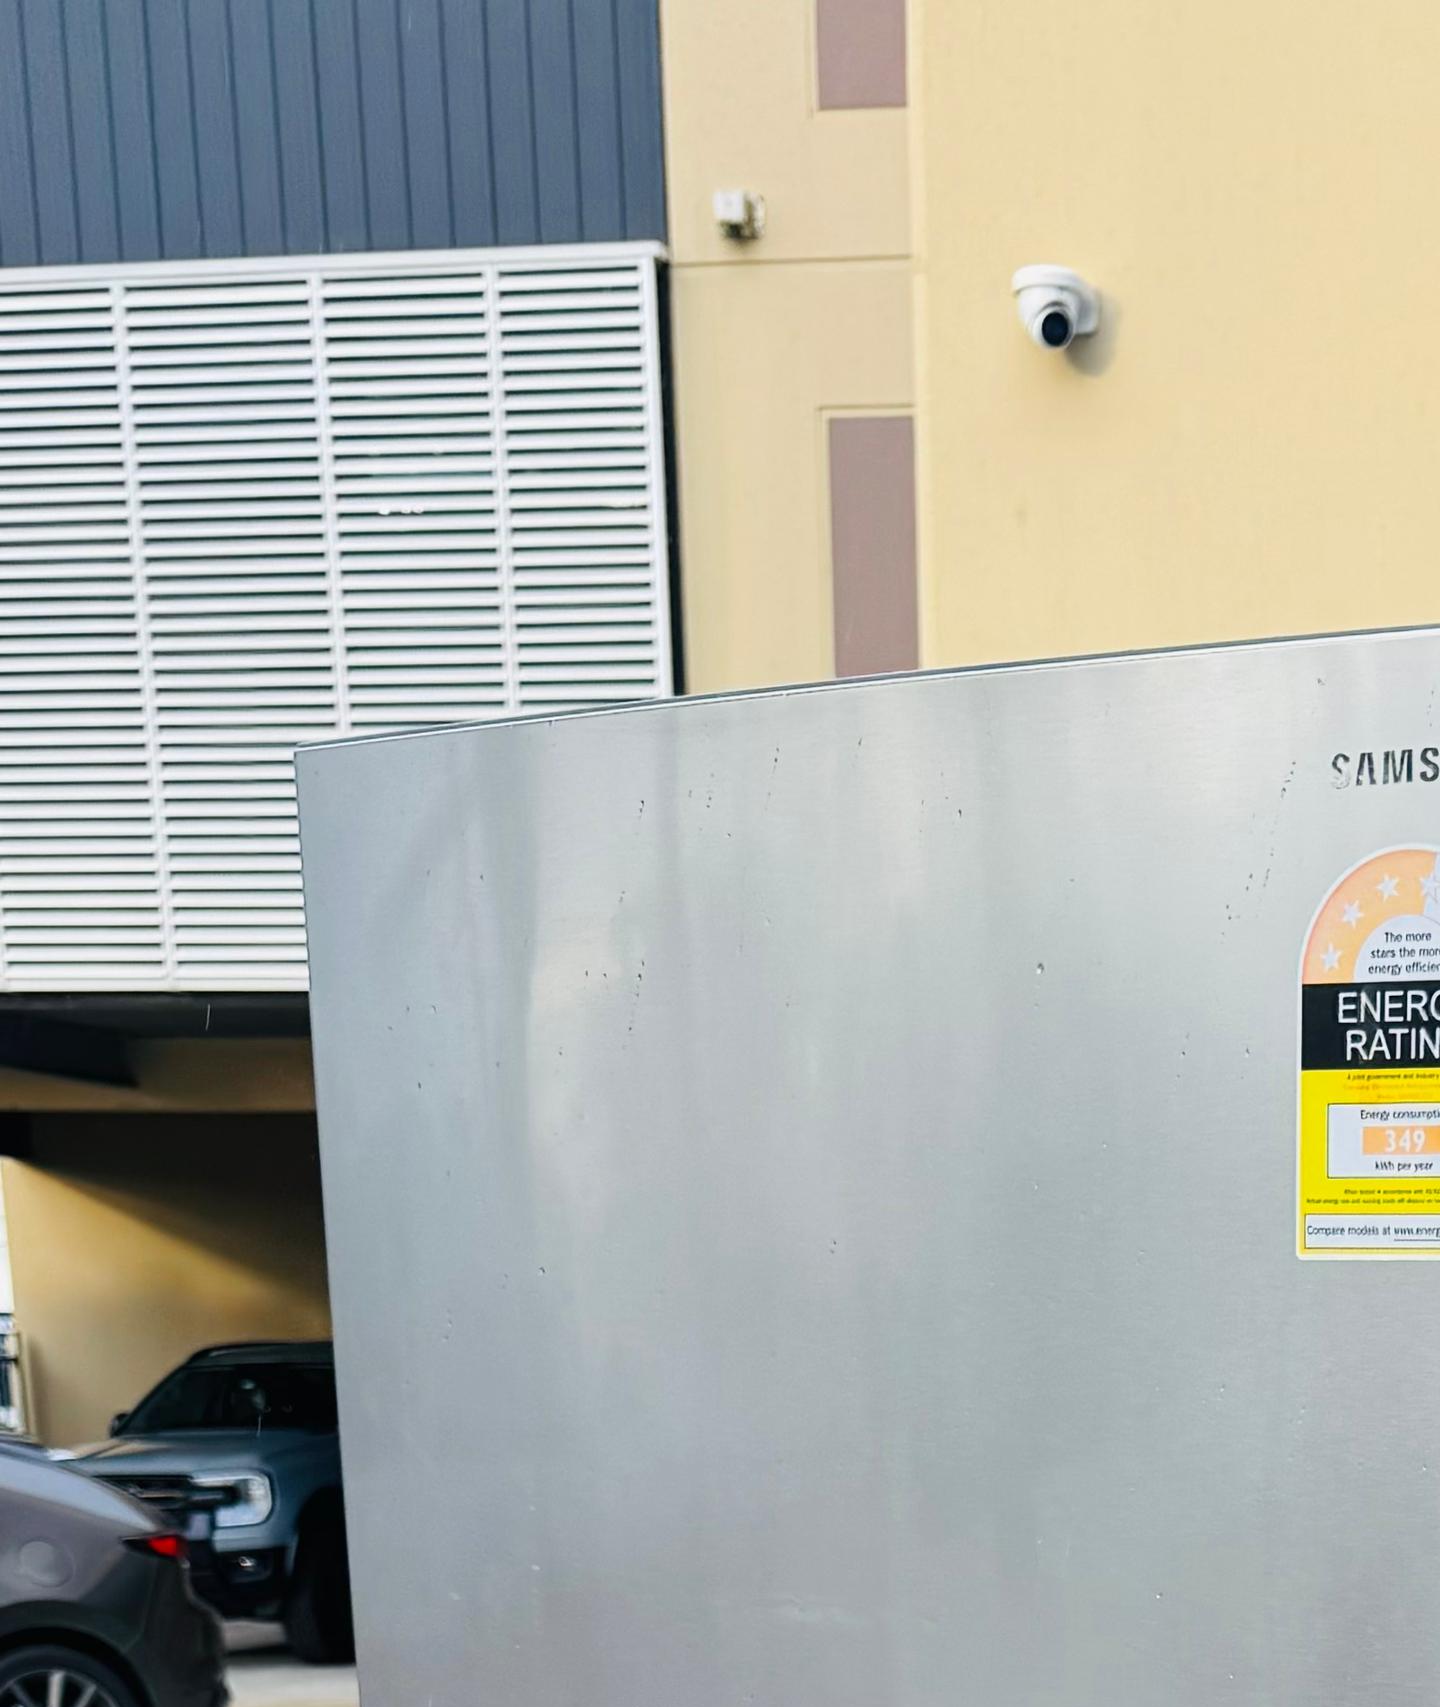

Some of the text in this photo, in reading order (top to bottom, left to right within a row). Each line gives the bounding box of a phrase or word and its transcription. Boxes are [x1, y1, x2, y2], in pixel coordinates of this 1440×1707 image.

[1384, 932, 1432, 942] The more
[1370, 949, 1396, 959] stars
[1399, 948, 1415, 958] the
[1368, 964, 1401, 976] energy
[1360, 1109, 1390, 1121] Energy
[1384, 1129, 1426, 1153] 349
[1375, 1161, 1433, 1172] kWh per year
[1307, 1225, 1345, 1236] Compare
[1347, 1225, 1379, 1235] models
[1382, 1226, 1391, 1235] at
